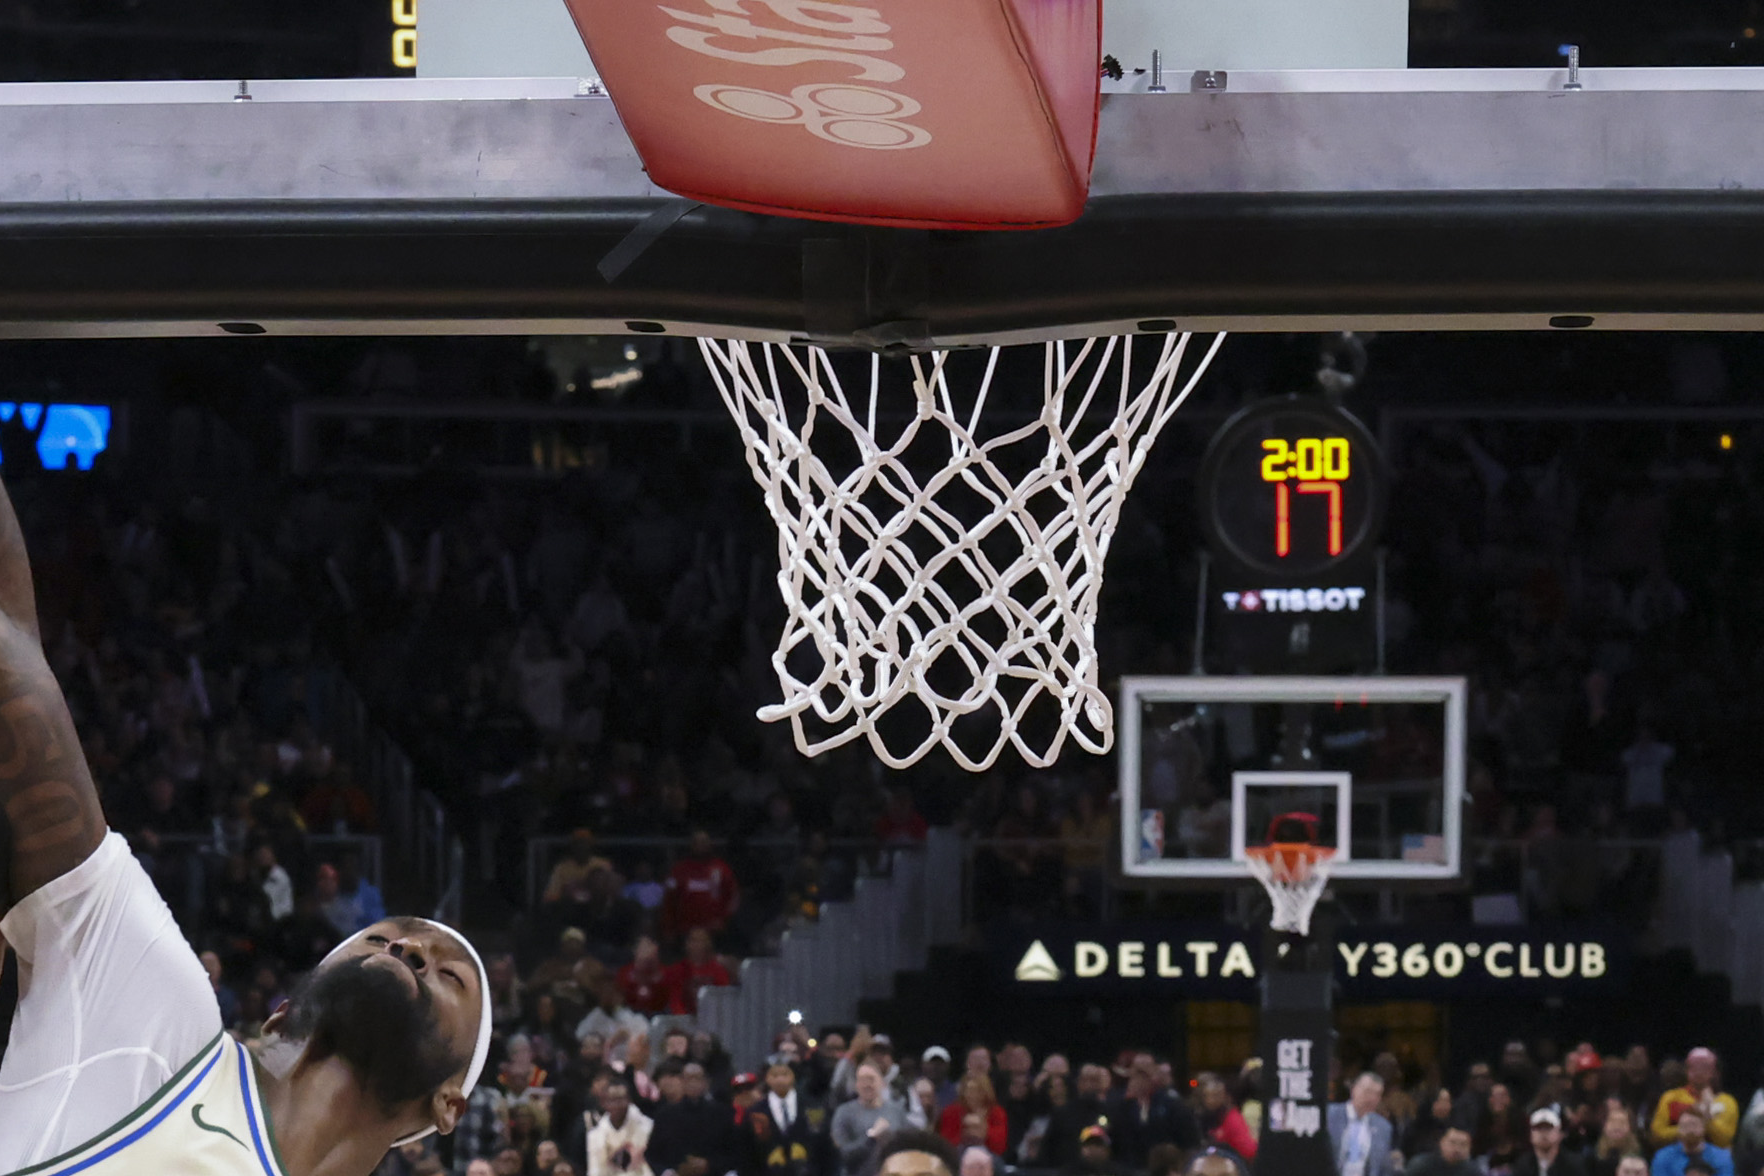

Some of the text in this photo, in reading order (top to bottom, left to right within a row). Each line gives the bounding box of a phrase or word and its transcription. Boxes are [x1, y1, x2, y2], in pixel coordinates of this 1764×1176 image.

[1261, 437, 1350, 482] 2:00
[1275, 481, 1343, 557] 17
[1260, 586, 1366, 612] TISSOT
[1074, 941, 1256, 978] DELTA
[1277, 1039, 1313, 1069] GET
